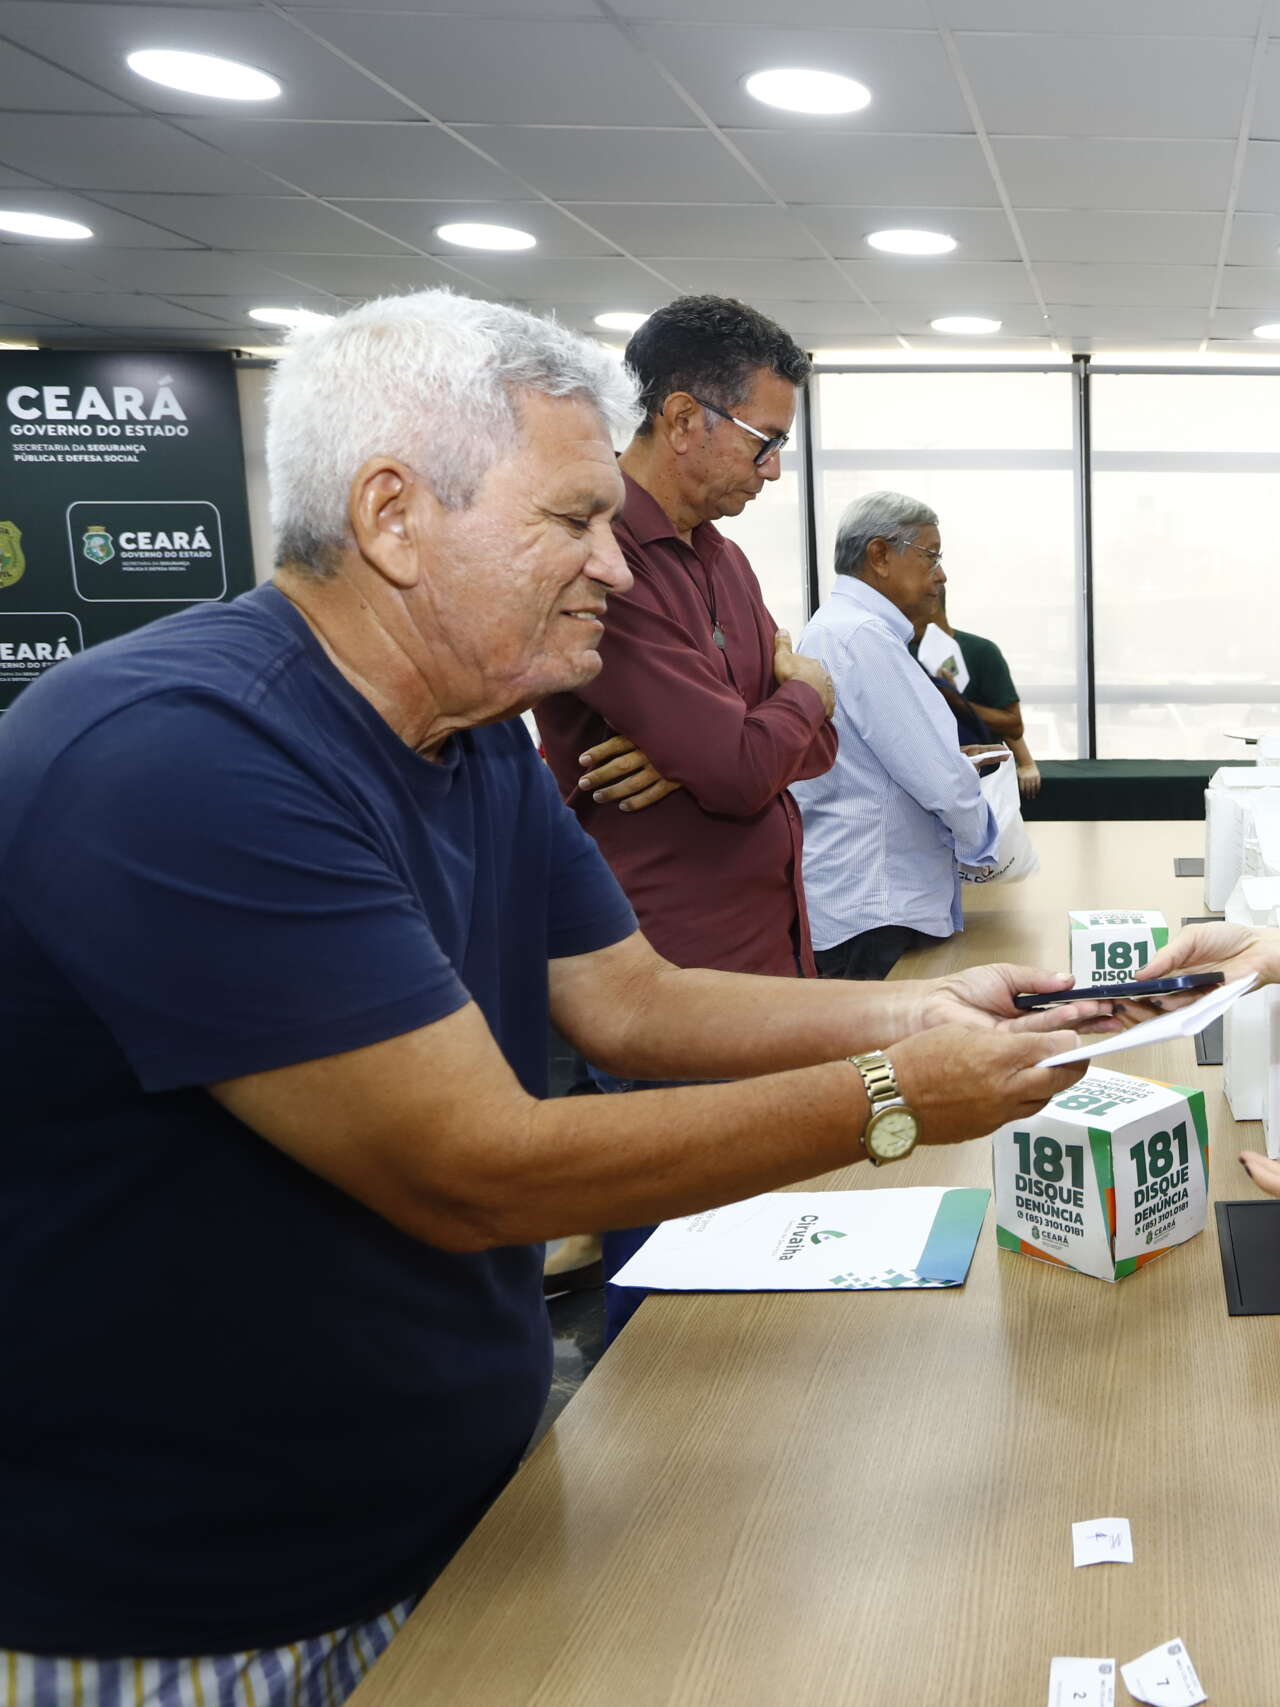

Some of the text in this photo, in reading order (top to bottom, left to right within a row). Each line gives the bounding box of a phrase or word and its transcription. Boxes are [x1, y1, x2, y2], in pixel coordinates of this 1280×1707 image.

[6, 375, 187, 421] CEARÁ
[10, 424, 189, 437] GOVERNO DO ESTADO
[12, 443, 147, 454] SECRETARIA DA SEGURANÇA
[14, 453, 56, 462] PÚBLICA
[118, 526, 211, 550] CEARÁ
[1091, 941, 1148, 970] 181
[1013, 1131, 1084, 1190] 181
[1130, 1121, 1190, 1188] 181
[1015, 1173, 1085, 1210] DISQUE
[1133, 1165, 1190, 1209] DISQUE
[1016, 1194, 1084, 1226] DENÚNCIA
[1134, 1187, 1189, 1226] DENÚNCIA
[1025, 1212, 1084, 1238] (85) 3101.0181
[1041, 1230, 1069, 1244] CEARÁ
[1073, 1691, 1088, 1700] 2
